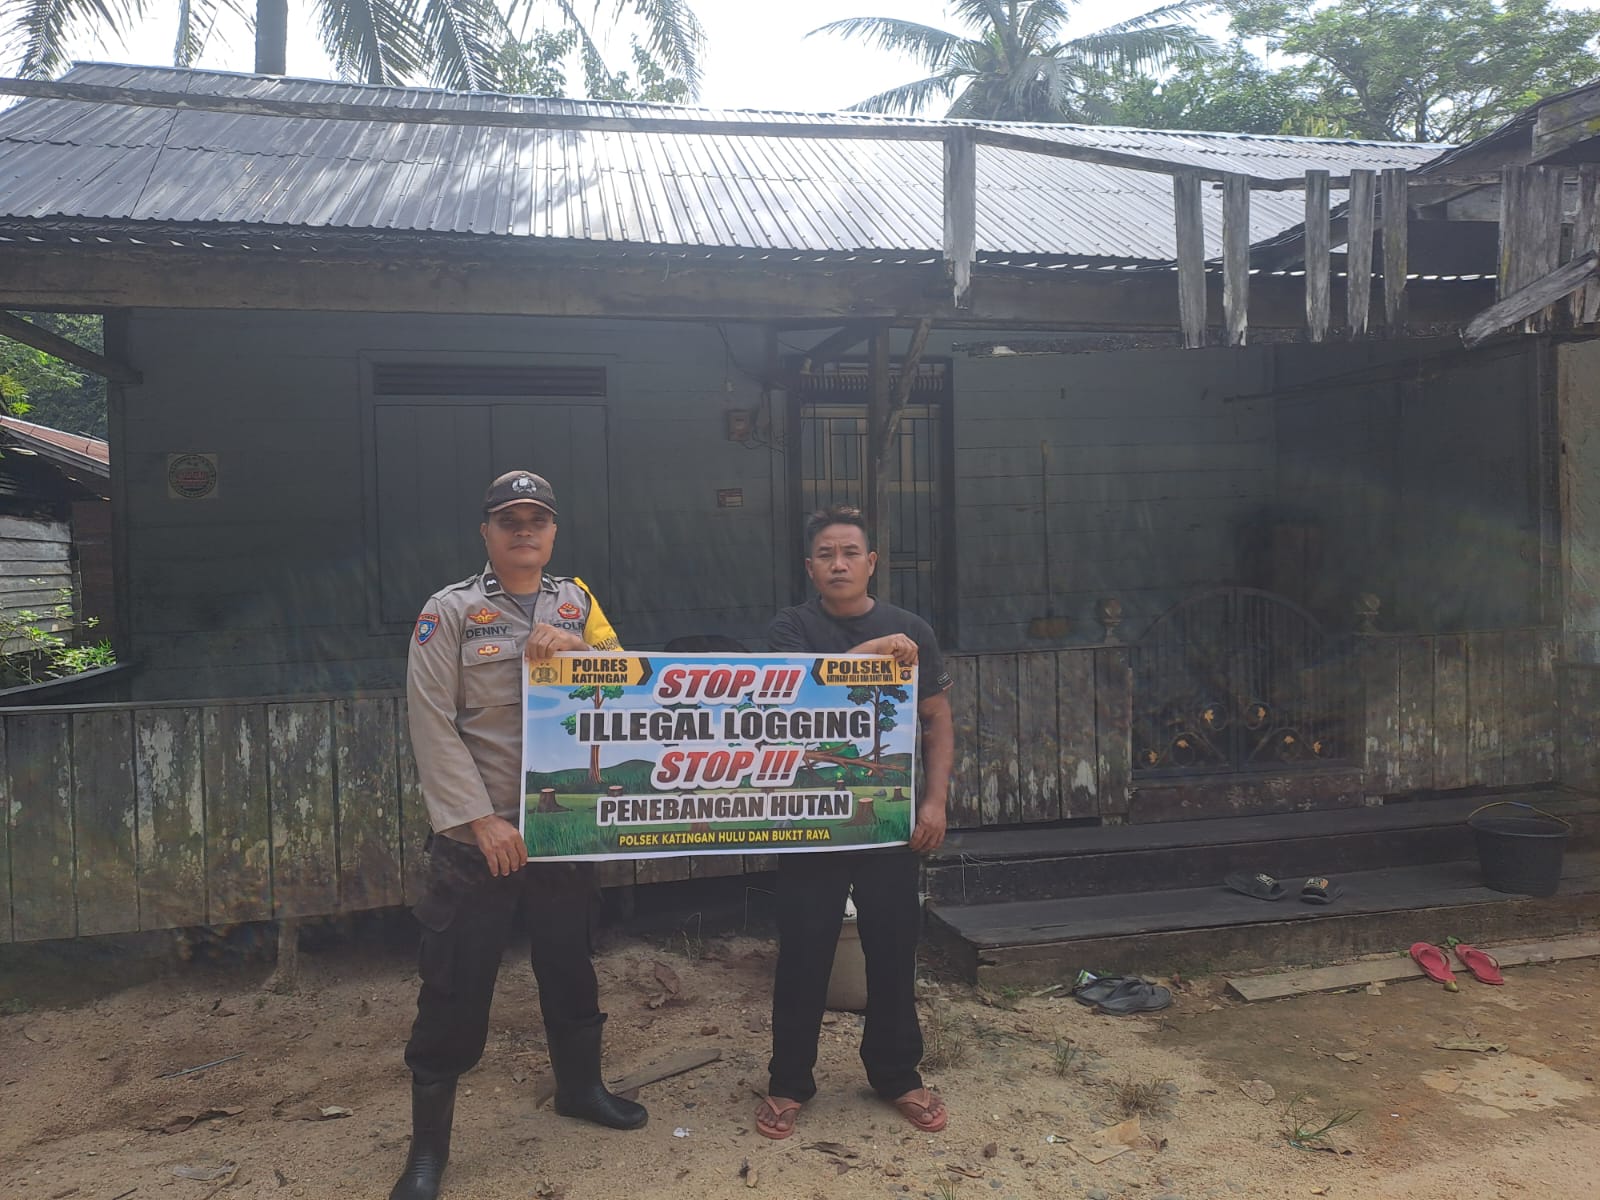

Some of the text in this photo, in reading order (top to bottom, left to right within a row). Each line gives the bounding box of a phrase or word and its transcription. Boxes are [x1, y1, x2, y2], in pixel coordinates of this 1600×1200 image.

[465, 625, 508, 639] DENNY
[553, 621, 585, 630] POLR
[572, 658, 628, 672] POLRES
[827, 661, 892, 675] POLSEK
[572, 673, 628, 684] KATINGAN
[579, 710, 871, 742] ILLEGAL LOGGING
[600, 794, 850, 822] PENEBANGAN HUTAN
[619, 829, 830, 846] POLSEK KATINGAN HULU DAN BUKIT RAYA
